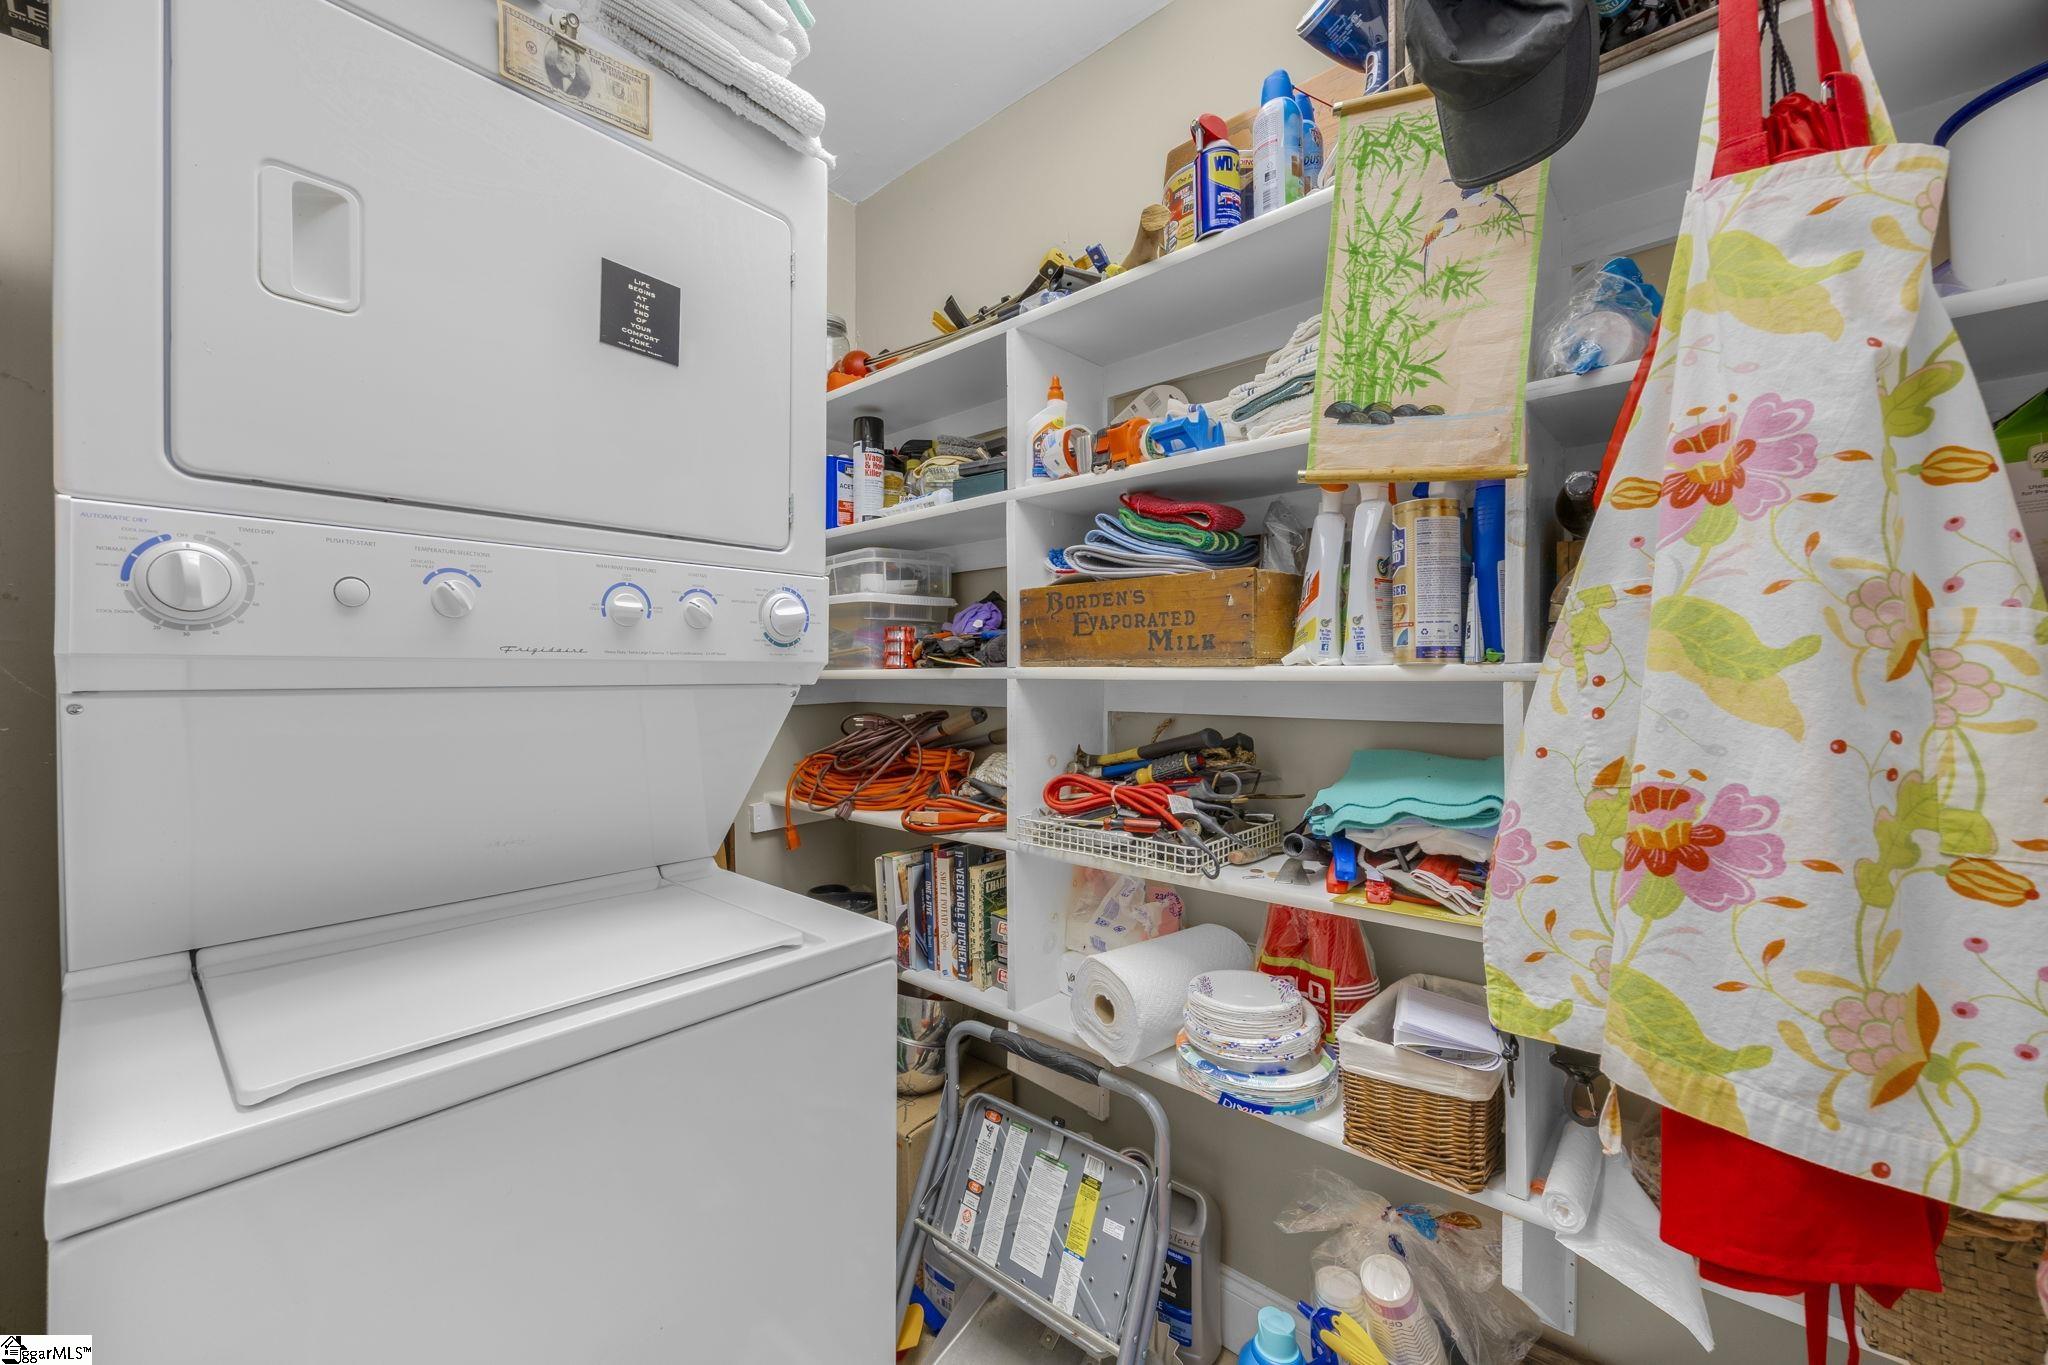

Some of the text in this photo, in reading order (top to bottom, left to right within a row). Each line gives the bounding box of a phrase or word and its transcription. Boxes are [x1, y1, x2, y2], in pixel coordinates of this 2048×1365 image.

[634, 278, 650, 289] LIFE
[628, 284, 656, 298] BEGINS
[633, 301, 650, 311] THE
[634, 308, 650, 318] END
[630, 322, 652, 333] YOUR
[621, 327, 660, 344] COMFORT
[864, 454, 883, 463] Wasp
[864, 469, 882, 478] Killer
[80, 511, 131, 523] AUTOMATIC
[238, 527, 276, 536] TIMED DRY
[325, 537, 346, 545] PUSH
[357, 540, 376, 548] START
[96, 545, 127, 553] NORMAL
[414, 545, 457, 555] TEMPERATURE
[1046, 589, 1146, 619] BORDEN'S
[1072, 610, 1196, 636] EVAPORATED
[1148, 629, 1217, 651] MILK
[940, 871, 948, 896] SWEET
[941, 899, 950, 926] POTATO
[956, 868, 967, 964] VEGETABLE BUTCHER
